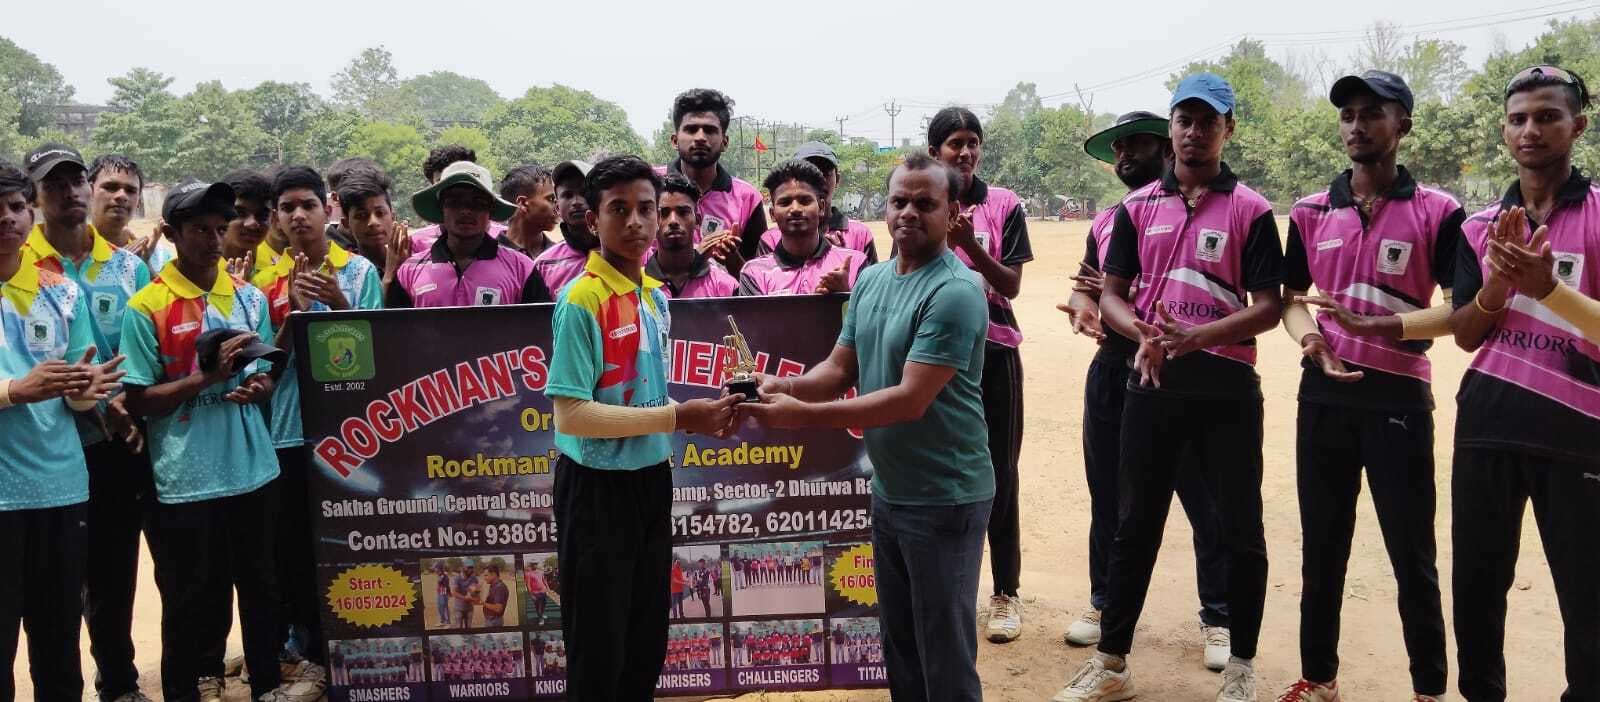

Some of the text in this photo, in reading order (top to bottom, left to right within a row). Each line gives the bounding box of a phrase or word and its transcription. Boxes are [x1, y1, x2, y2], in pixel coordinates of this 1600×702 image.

[345, 381, 366, 391] 2002
[313, 345, 549, 480] ROCKMAN'S
[426, 449, 560, 479] Rockman'
[682, 441, 804, 469] Academy
[321, 500, 375, 518] Sakha
[377, 495, 442, 515] Ground,
[444, 492, 507, 512] Central
[510, 490, 554, 509] Scho
[672, 486, 711, 502] amp,
[713, 480, 786, 500] Sector-2
[788, 478, 852, 497] Dhurwa
[348, 527, 433, 551] Contact
[438, 525, 480, 547] No.:
[484, 521, 559, 546] 938615
[854, 555, 875, 569] Fin
[349, 576, 383, 591] Start
[839, 574, 875, 589] 16/06
[335, 593, 408, 611] 16/05/2024
[655, 672, 712, 689] UNRISERS
[737, 668, 820, 686] CHALLENGERS
[349, 685, 411, 702] SMASHERS
[449, 682, 511, 698] WARRIORS
[535, 679, 567, 694] KNIG
